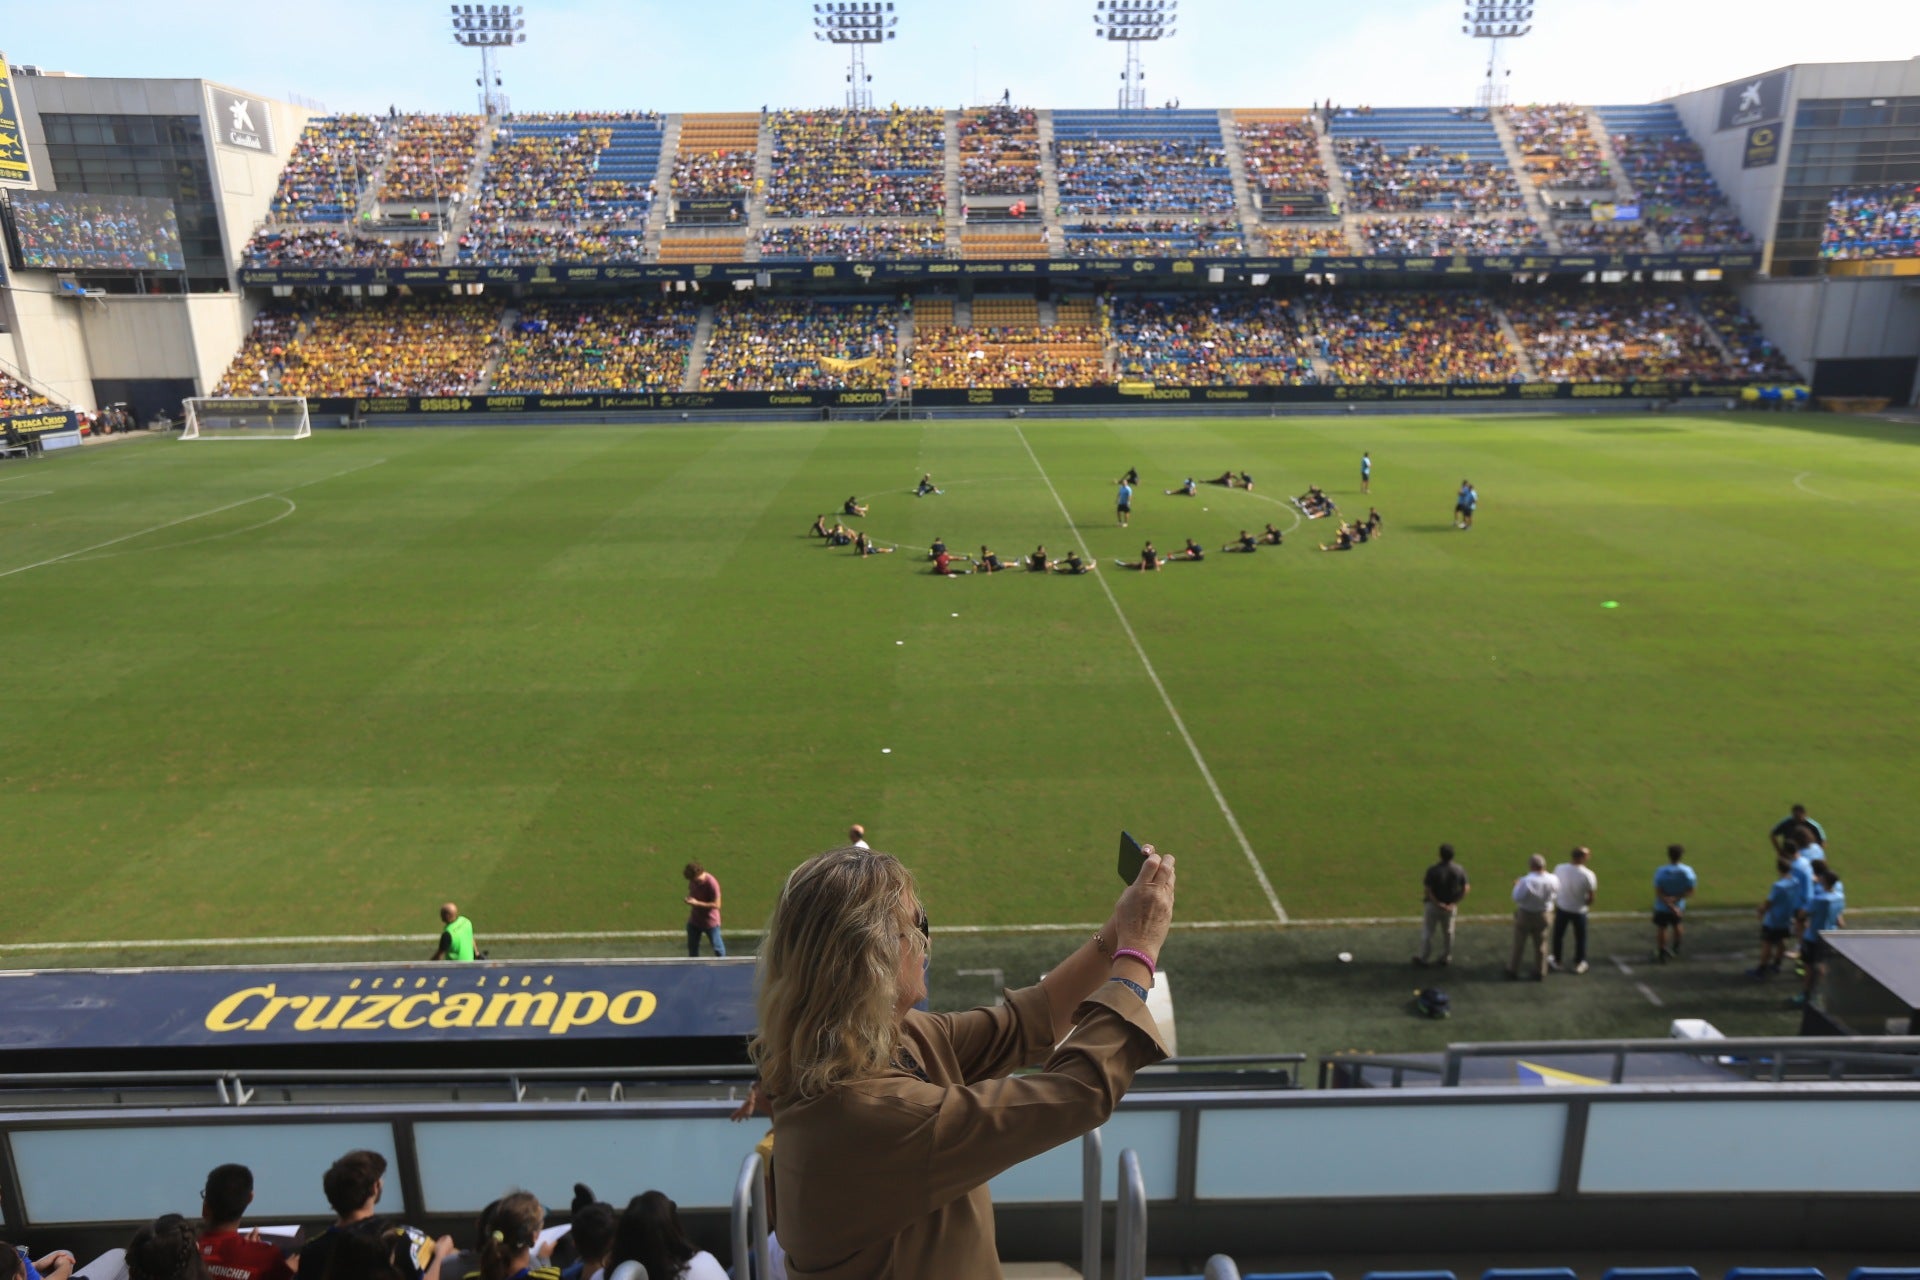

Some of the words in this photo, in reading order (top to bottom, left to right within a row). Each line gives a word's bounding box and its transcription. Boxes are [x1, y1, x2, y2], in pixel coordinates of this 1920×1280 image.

[420, 398, 460, 411] asisa
[540, 399, 563, 408] Grupo
[769, 395, 812, 404] Cruzcampo
[205, 983, 657, 1034] Cruzcampo
